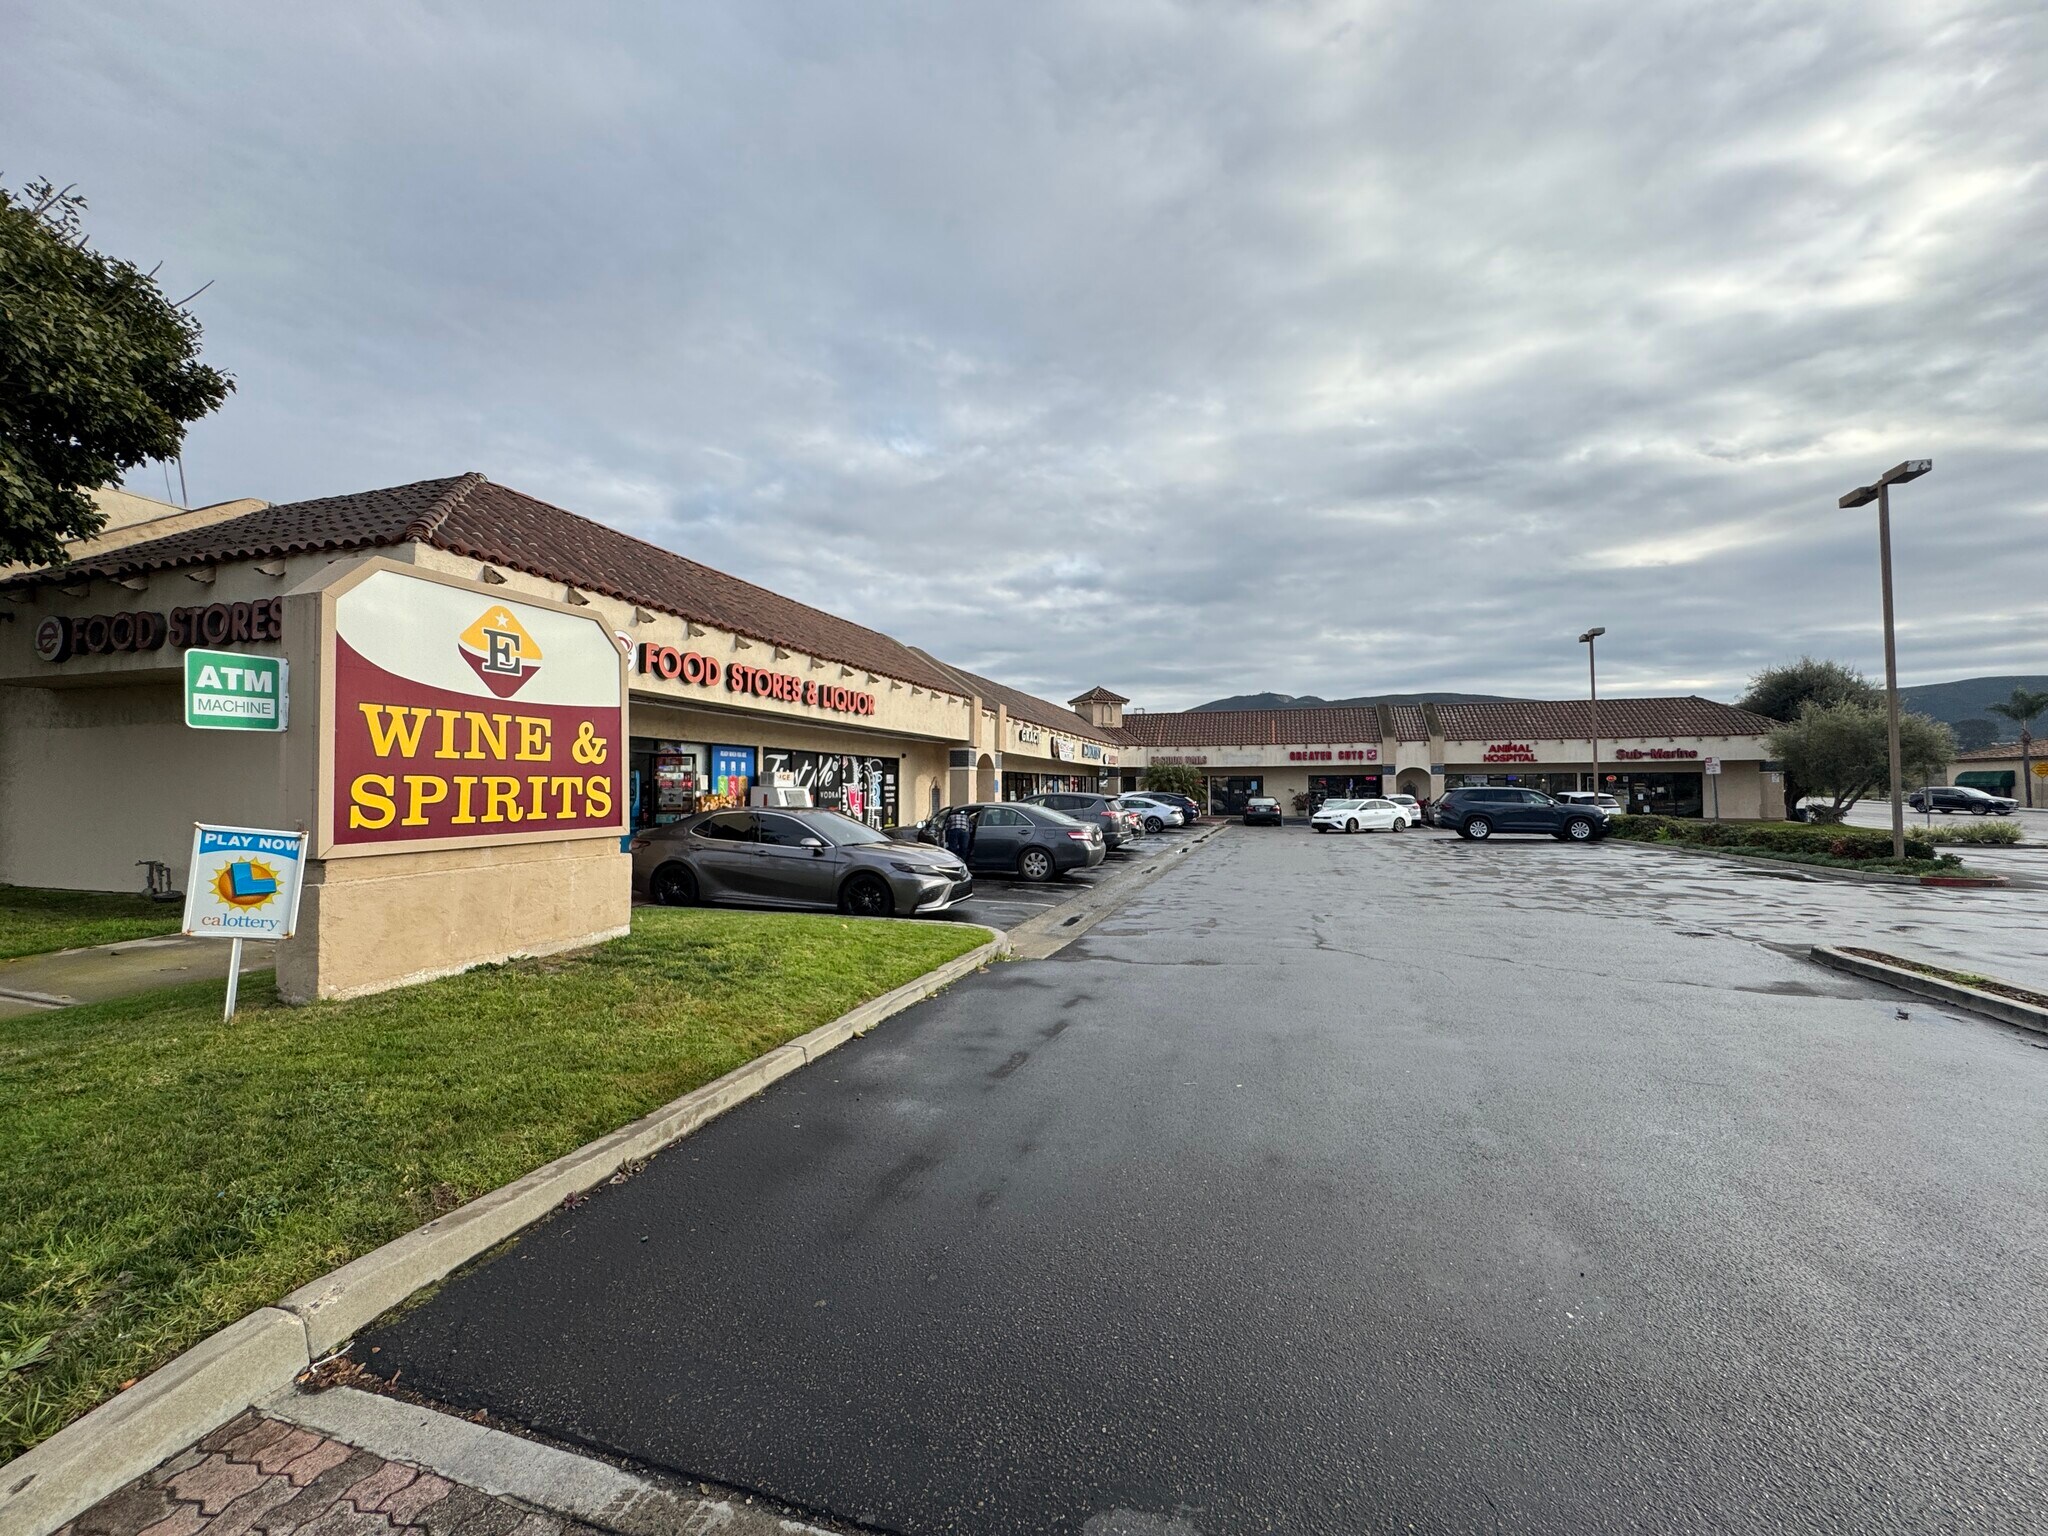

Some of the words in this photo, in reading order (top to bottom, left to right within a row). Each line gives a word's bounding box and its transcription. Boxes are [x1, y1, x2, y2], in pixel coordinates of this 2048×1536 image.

[71, 610, 158, 655] FOOD
[483, 627, 521, 676] E
[196, 665, 273, 693] ATM
[644, 642, 721, 687] FOOD
[729, 663, 801, 702] STORES
[806, 680, 818, 705] &
[821, 684, 876, 715] LIQUOR
[198, 698, 272, 714] MACHINE
[358, 702, 552, 762] WINE
[571, 720, 608, 765] &
[1289, 751, 1332, 761] GREATER
[1338, 750, 1364, 761] CUTS
[1488, 744, 1533, 753] ANIMAL
[1616, 748, 1698, 760] Sub-Marine
[1483, 754, 1538, 762] HOSPITAL
[349, 773, 613, 830] SPIRITS
[204, 833, 254, 847] PLAY
[259, 837, 301, 851] NOW
[201, 913, 280, 931] calottery
